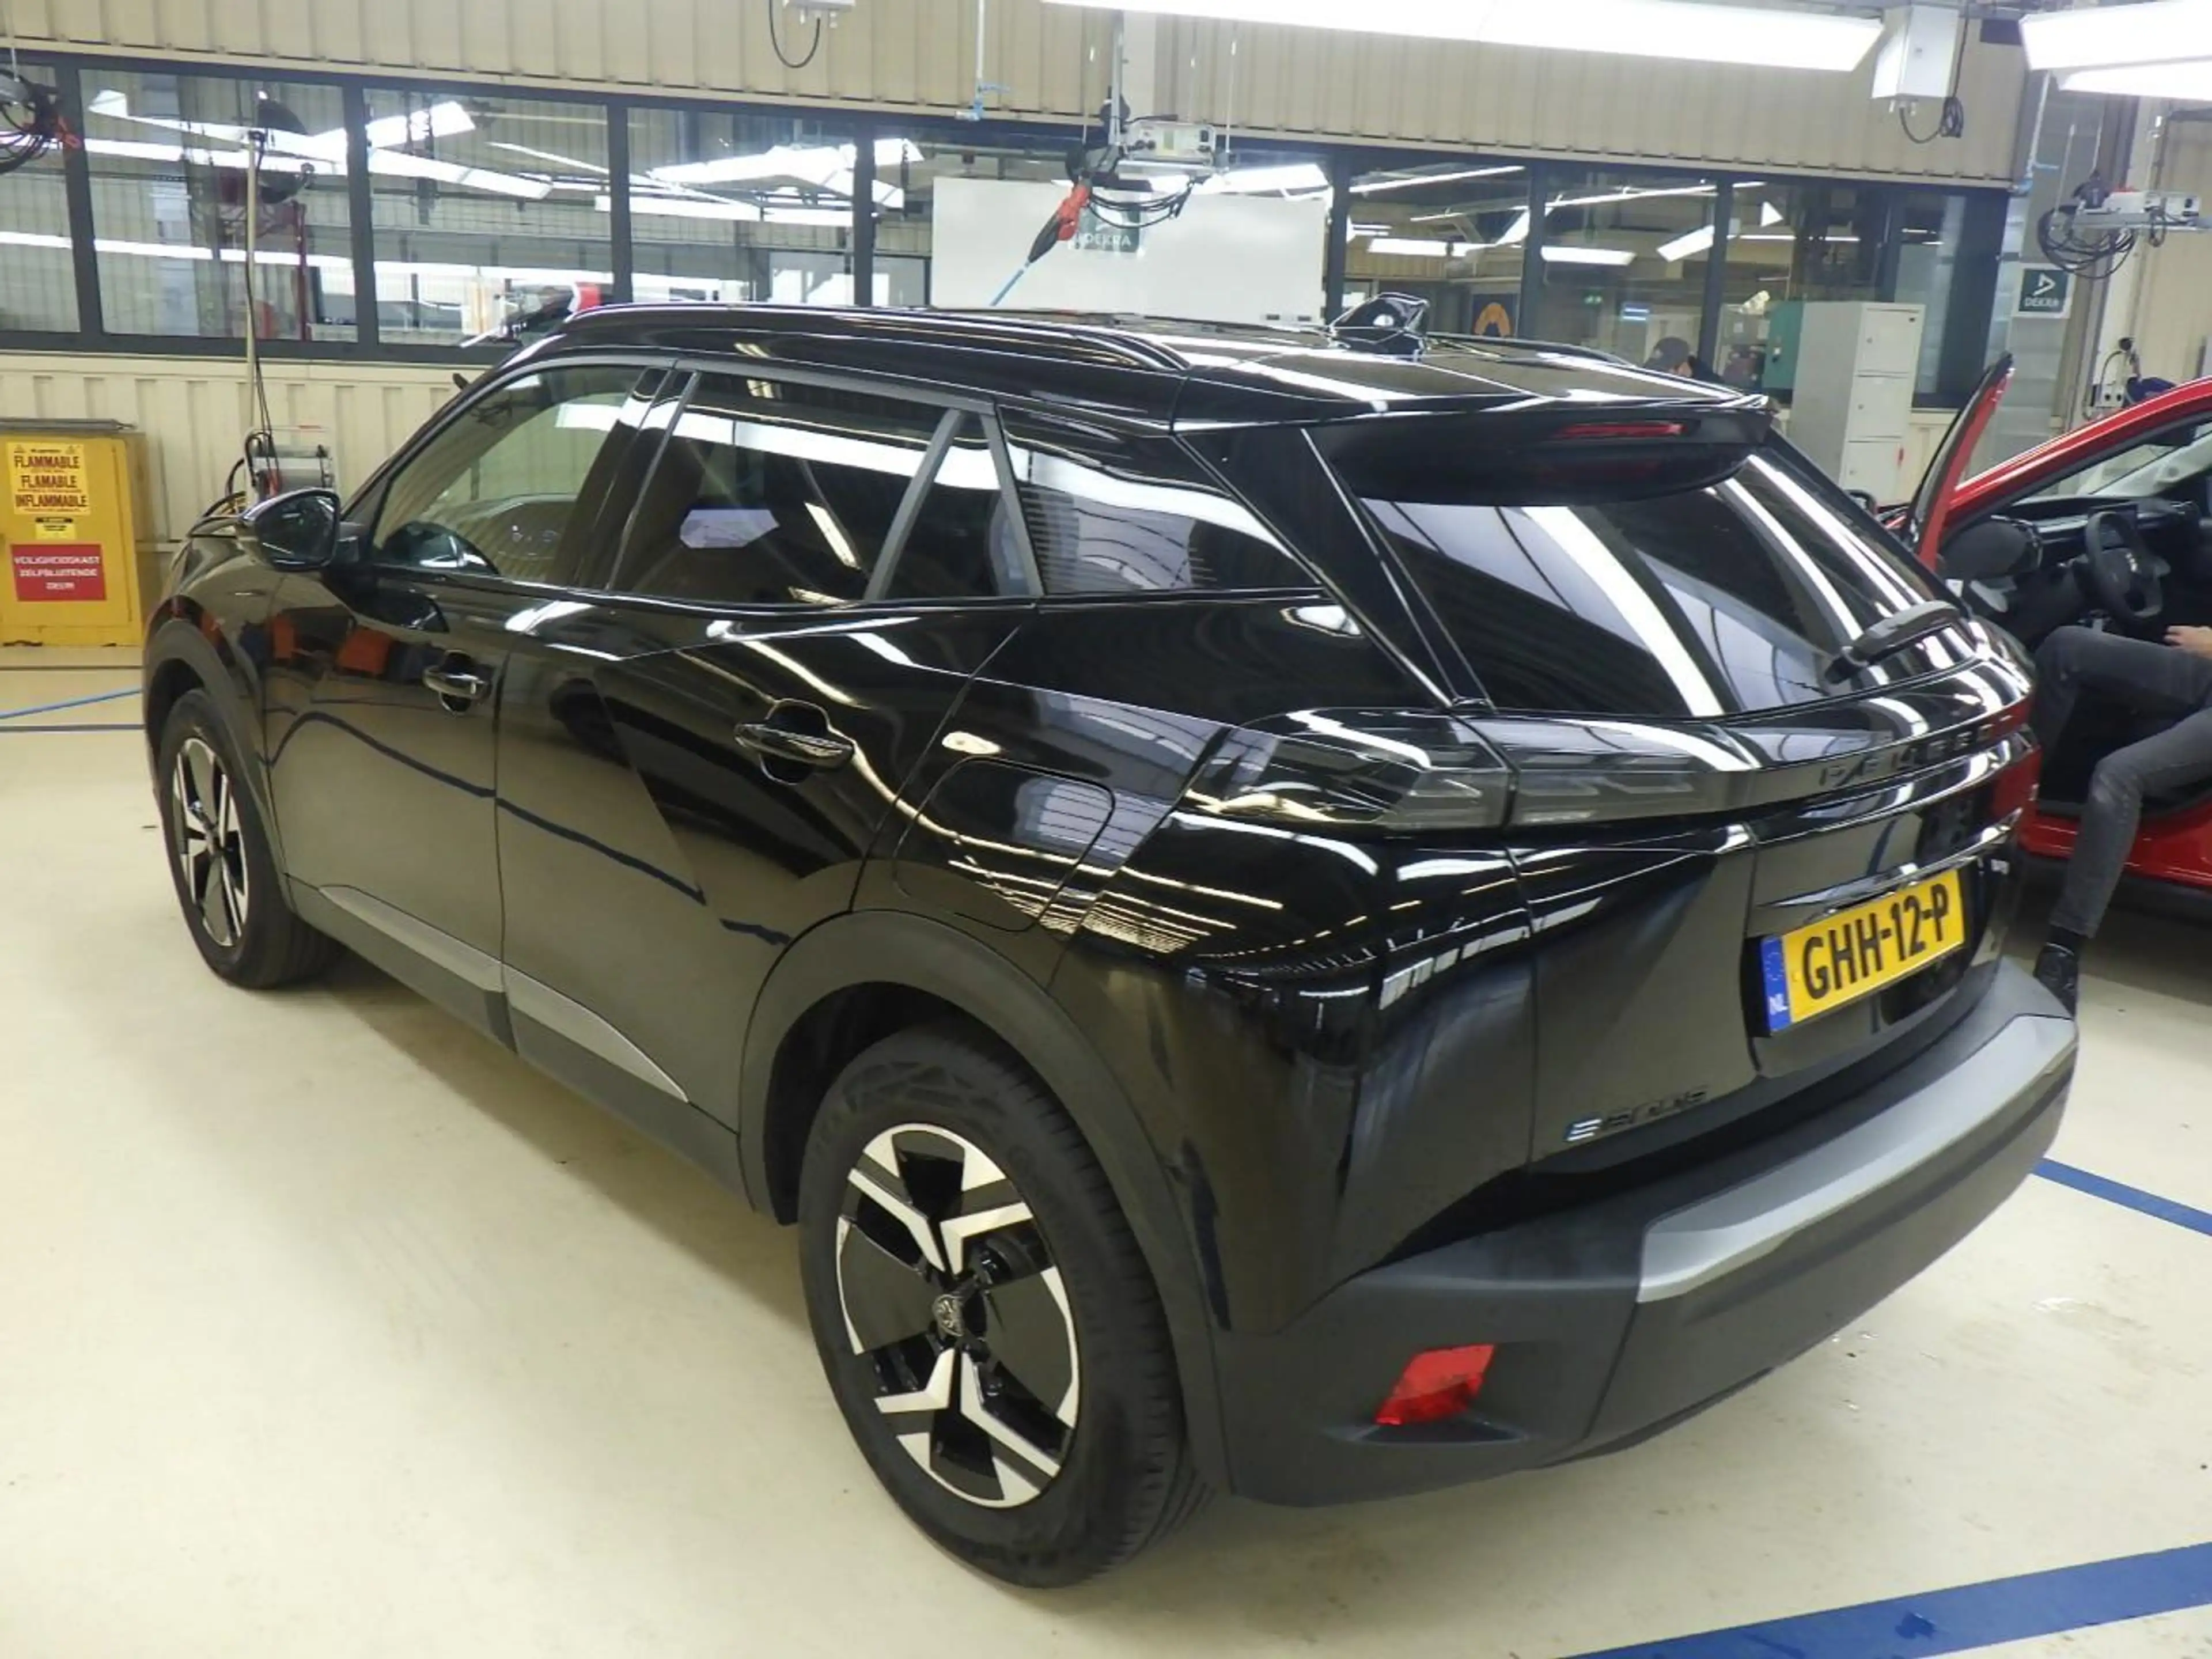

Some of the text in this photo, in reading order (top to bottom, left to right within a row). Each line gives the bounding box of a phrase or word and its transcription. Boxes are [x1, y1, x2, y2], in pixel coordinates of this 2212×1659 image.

[14, 456, 80, 469] FLAMMABLE
[21, 475, 77, 488] FLAMABLE
[16, 494, 88, 507] INFLAMMABLE
[1802, 883, 1948, 999] GHH-12-P
[1769, 993, 1788, 1015] NL
